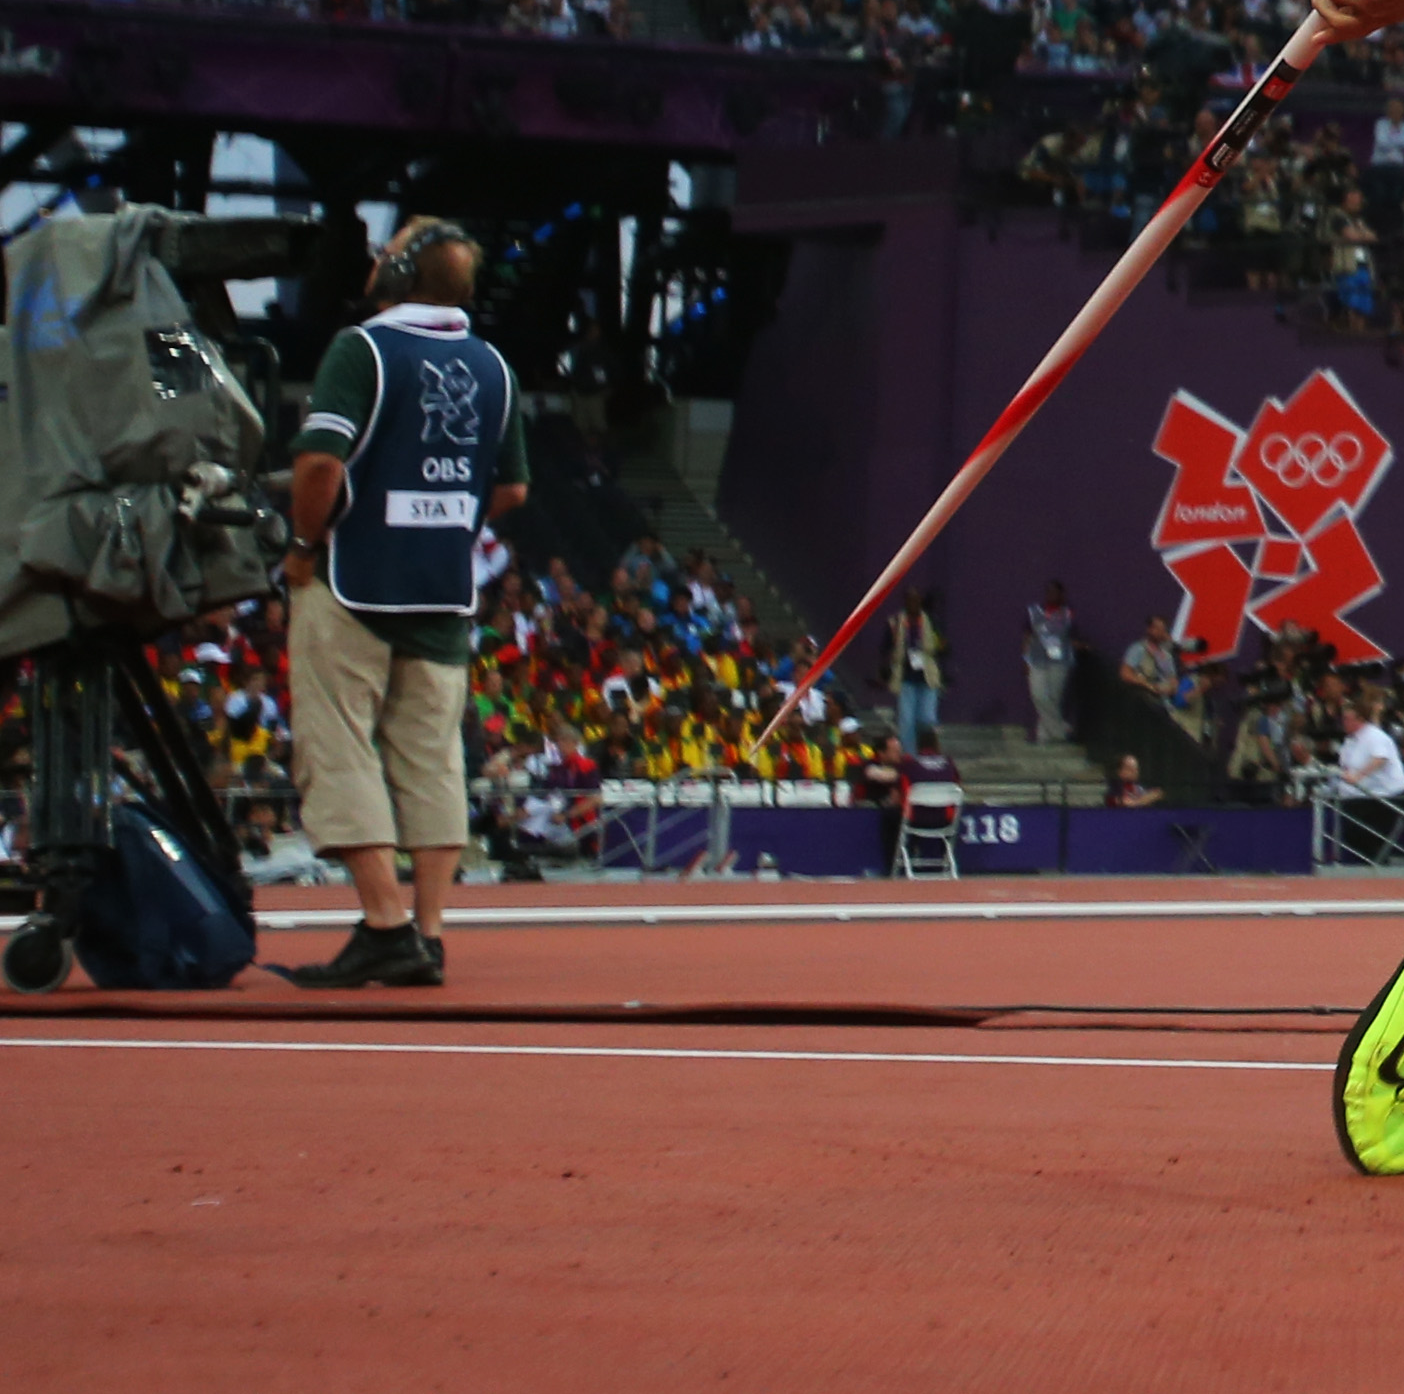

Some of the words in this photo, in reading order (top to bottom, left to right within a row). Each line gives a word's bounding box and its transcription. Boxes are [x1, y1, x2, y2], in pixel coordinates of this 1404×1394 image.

[422, 457, 472, 482] OBS
[411, 500, 447, 516] STA
[1174, 501, 1247, 523] london
[960, 813, 1019, 844] 118
